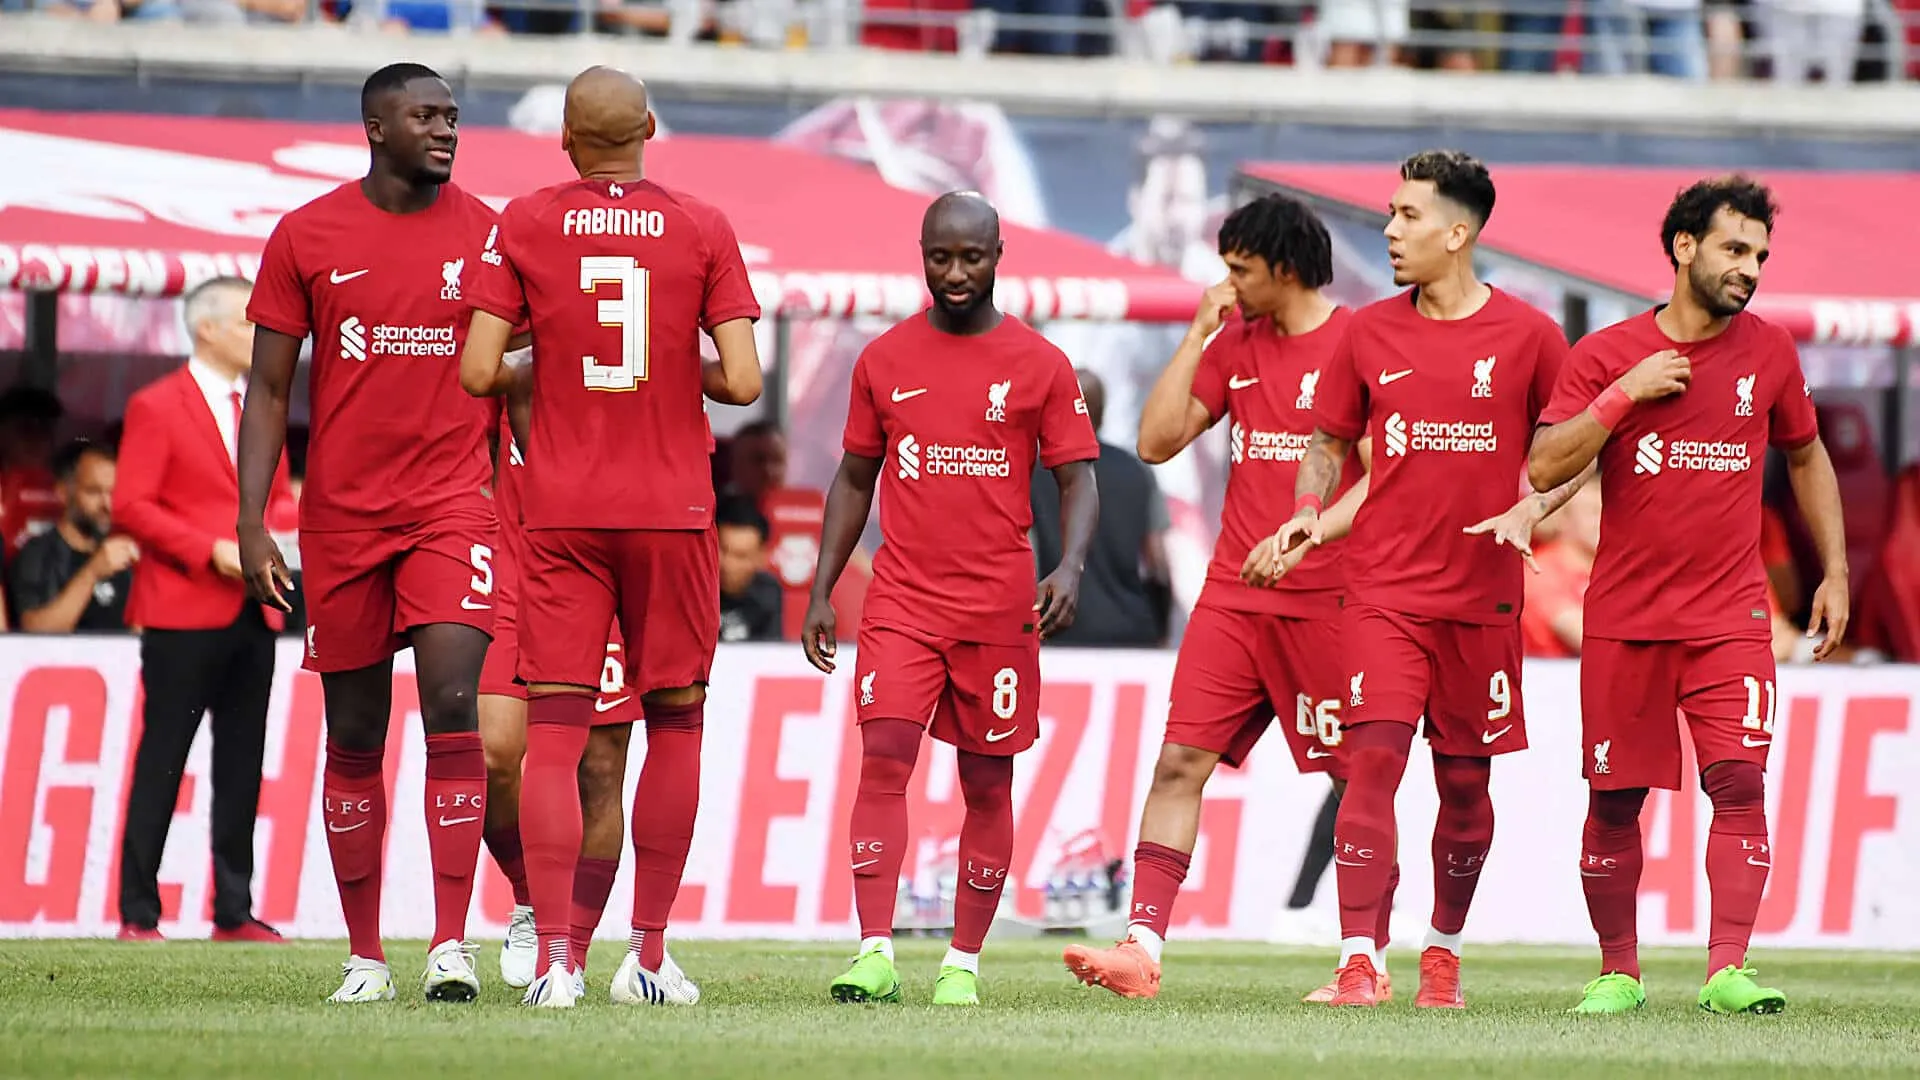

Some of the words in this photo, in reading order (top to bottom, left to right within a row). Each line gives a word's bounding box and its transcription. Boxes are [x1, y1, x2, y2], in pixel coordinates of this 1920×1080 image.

[563, 208, 665, 237] FABINHO
[440, 286, 463, 300] LFC
[372, 323, 454, 342] standard
[580, 256, 651, 392] 3
[371, 338, 457, 356] chartered
[1471, 384, 1493, 398] LFC
[985, 408, 1007, 423] LFC
[1734, 402, 1754, 417] LFC
[1411, 419, 1494, 438] standard
[926, 442, 1008, 463] standard
[1411, 434, 1498, 452] chartered
[1670, 438, 1748, 458] standard
[926, 457, 1010, 478] chartered
[1668, 452, 1752, 472] chartered
[470, 543, 494, 597] 5
[992, 667, 1019, 720] 8
[1488, 669, 1512, 721] 9
[1742, 676, 1777, 736] 11
[1296, 691, 1344, 747] 66
[851, 841, 884, 854] FC
[1582, 854, 1617, 869] FC
